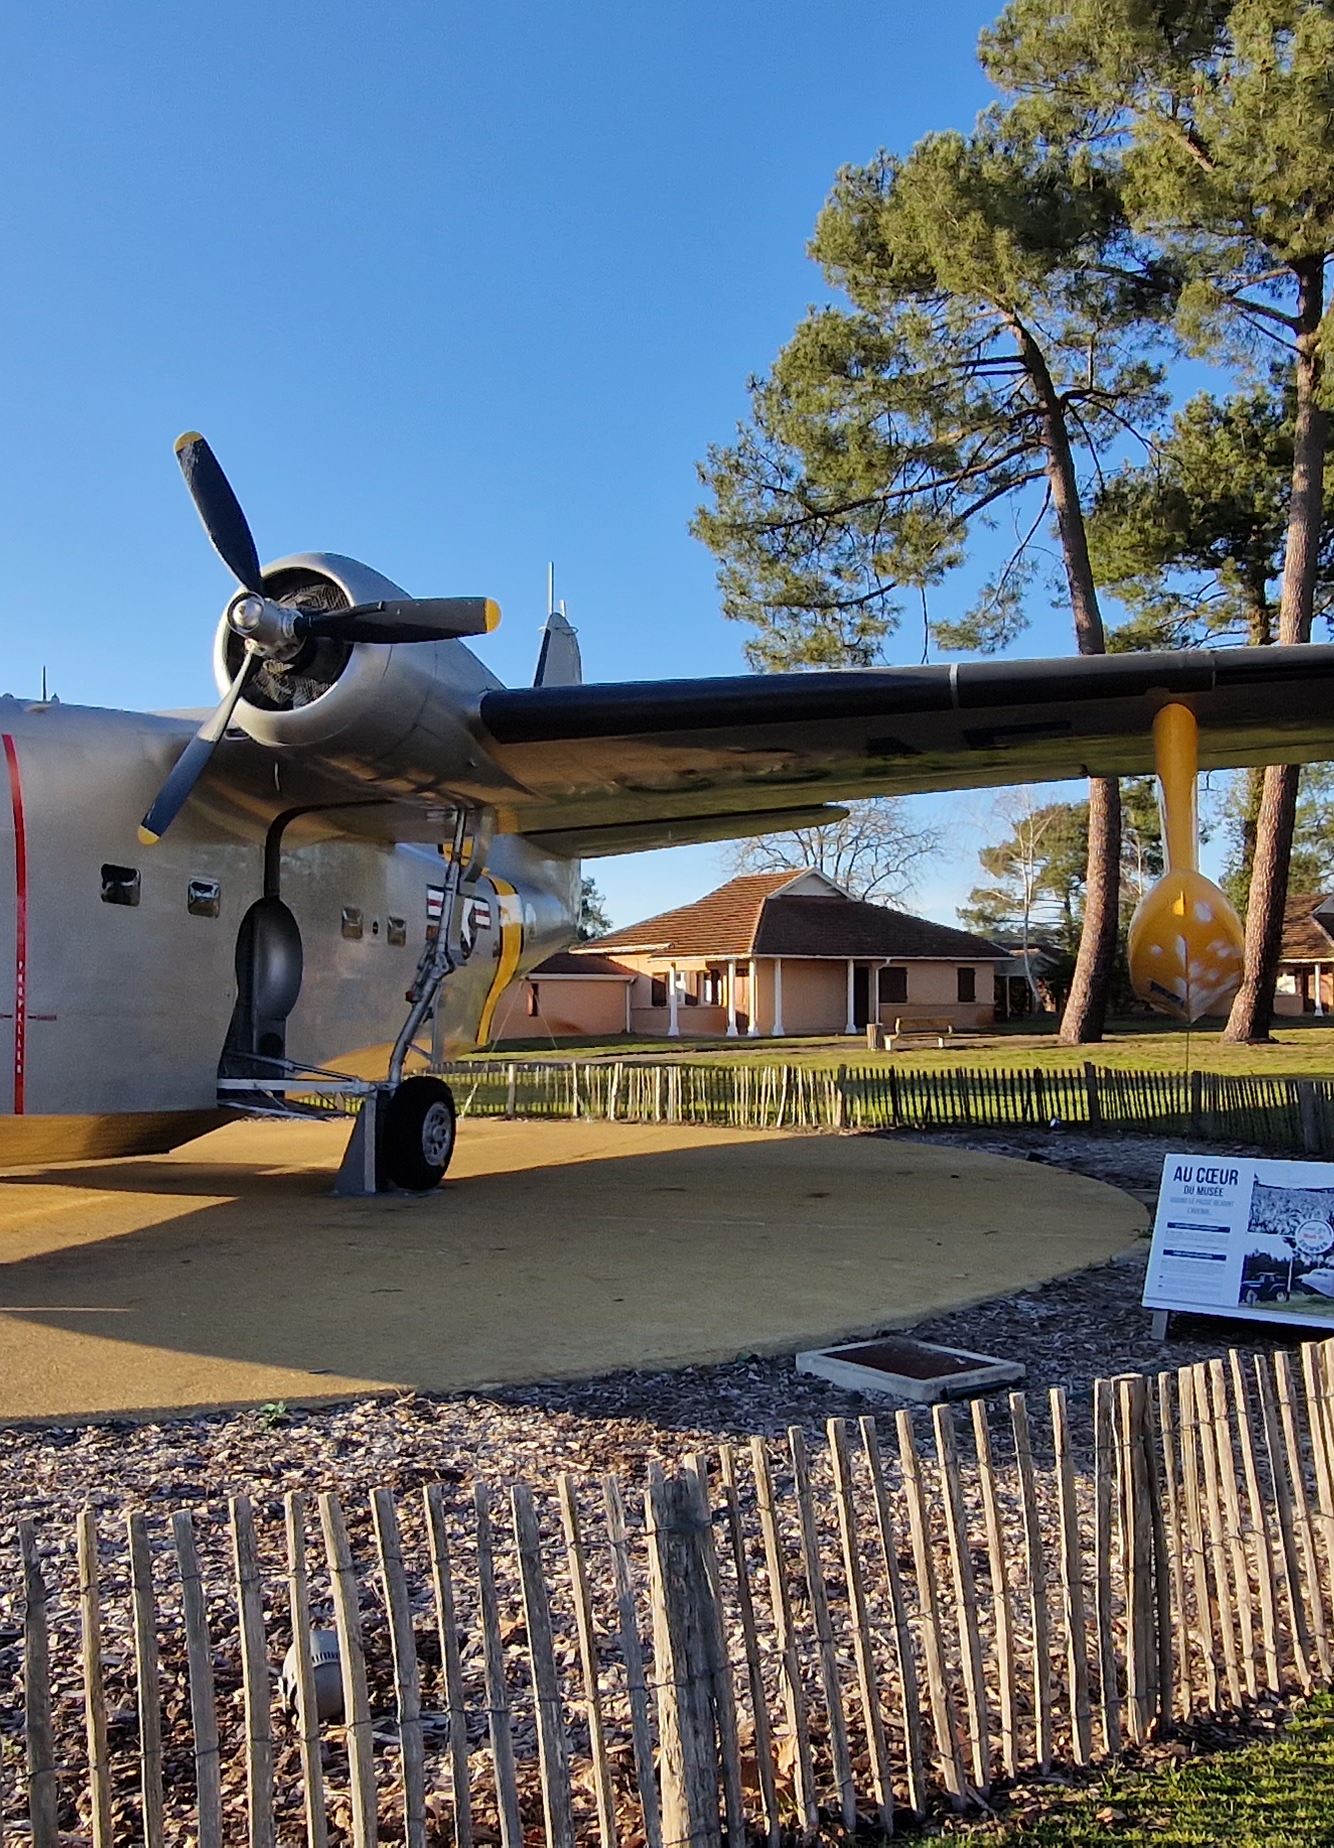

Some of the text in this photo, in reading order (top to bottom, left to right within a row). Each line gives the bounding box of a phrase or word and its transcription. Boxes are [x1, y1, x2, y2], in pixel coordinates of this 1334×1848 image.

[1173, 1166, 1239, 1186] AU CŒUR
[1183, 1185, 1224, 1197] DU MUSÉE
